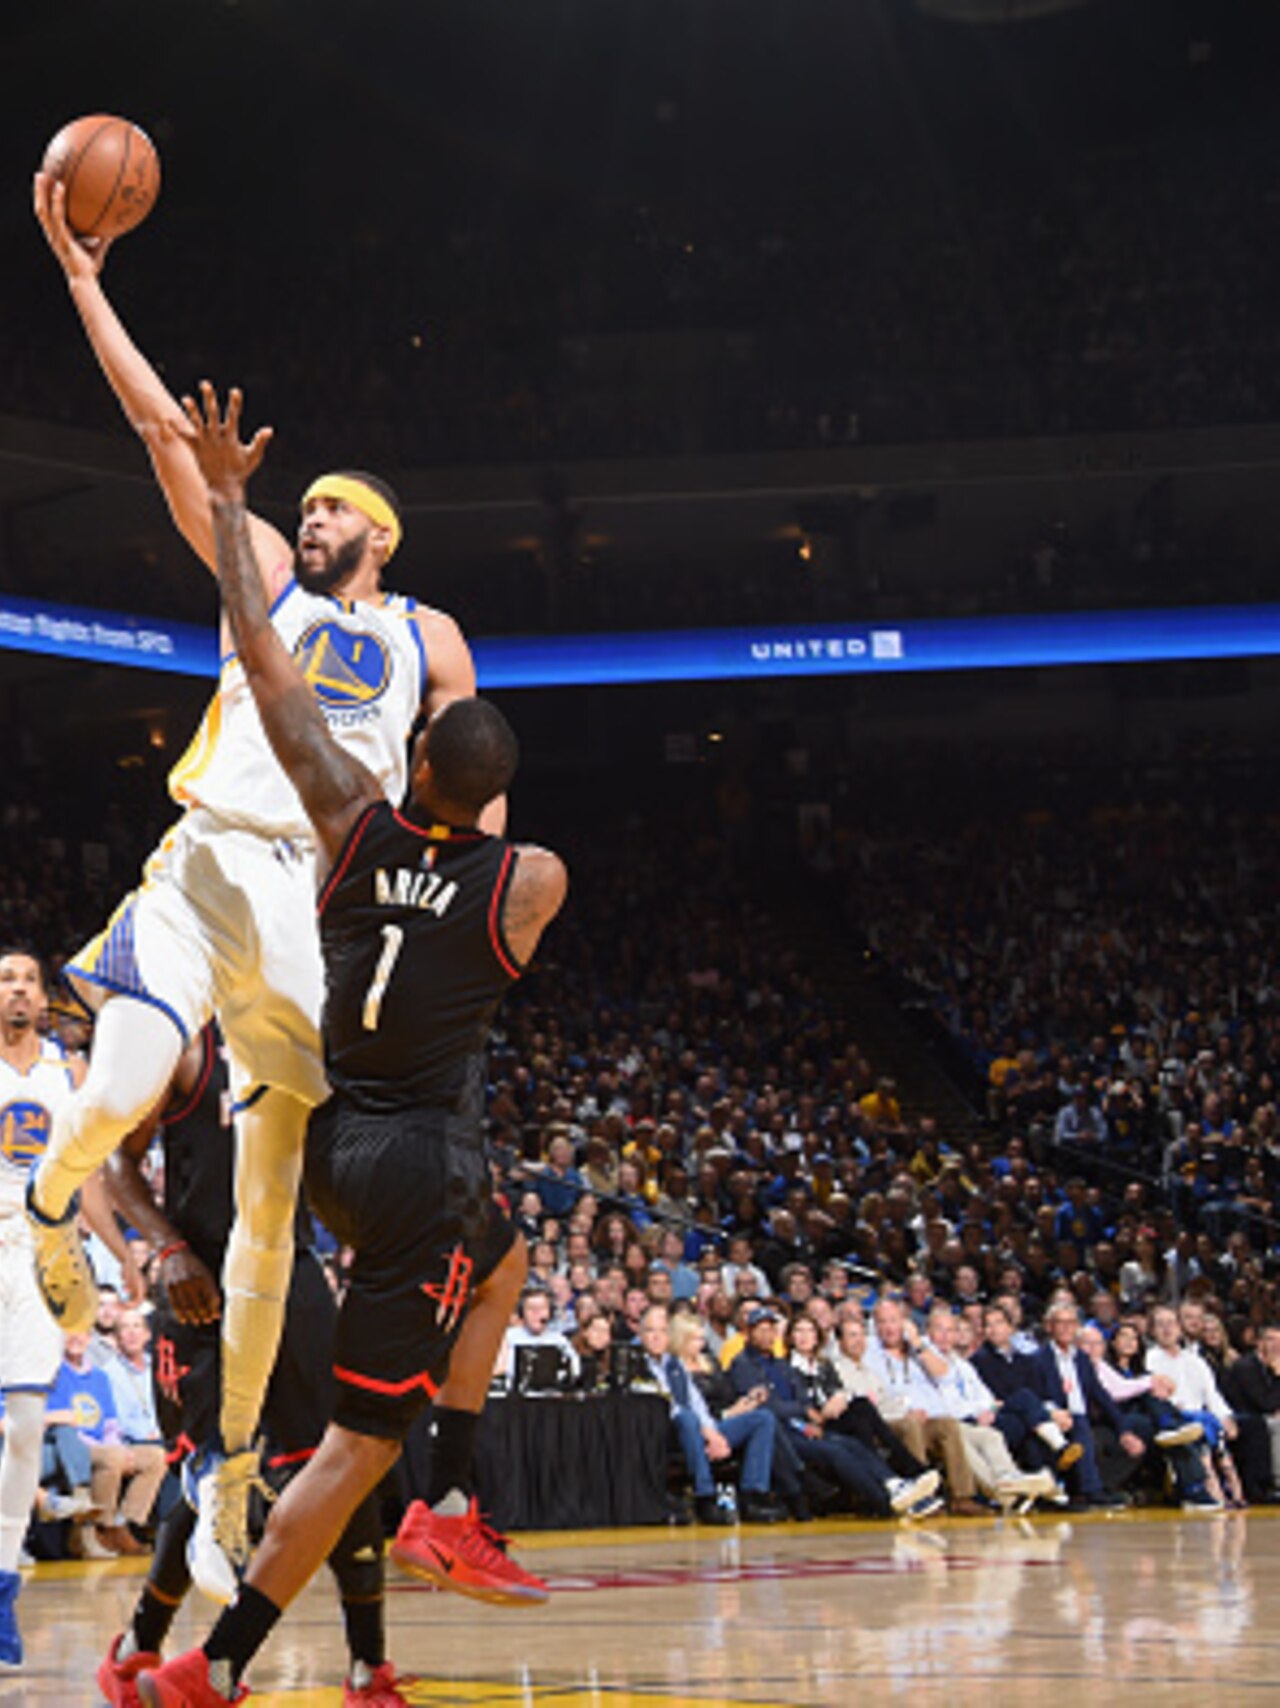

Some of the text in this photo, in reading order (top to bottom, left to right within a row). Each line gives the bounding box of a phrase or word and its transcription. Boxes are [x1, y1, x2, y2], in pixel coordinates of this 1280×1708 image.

[351, 639, 364, 664] 1
[751, 638, 866, 661] UNITED
[375, 867, 459, 918] ARIZA
[361, 923, 404, 1032] 1
